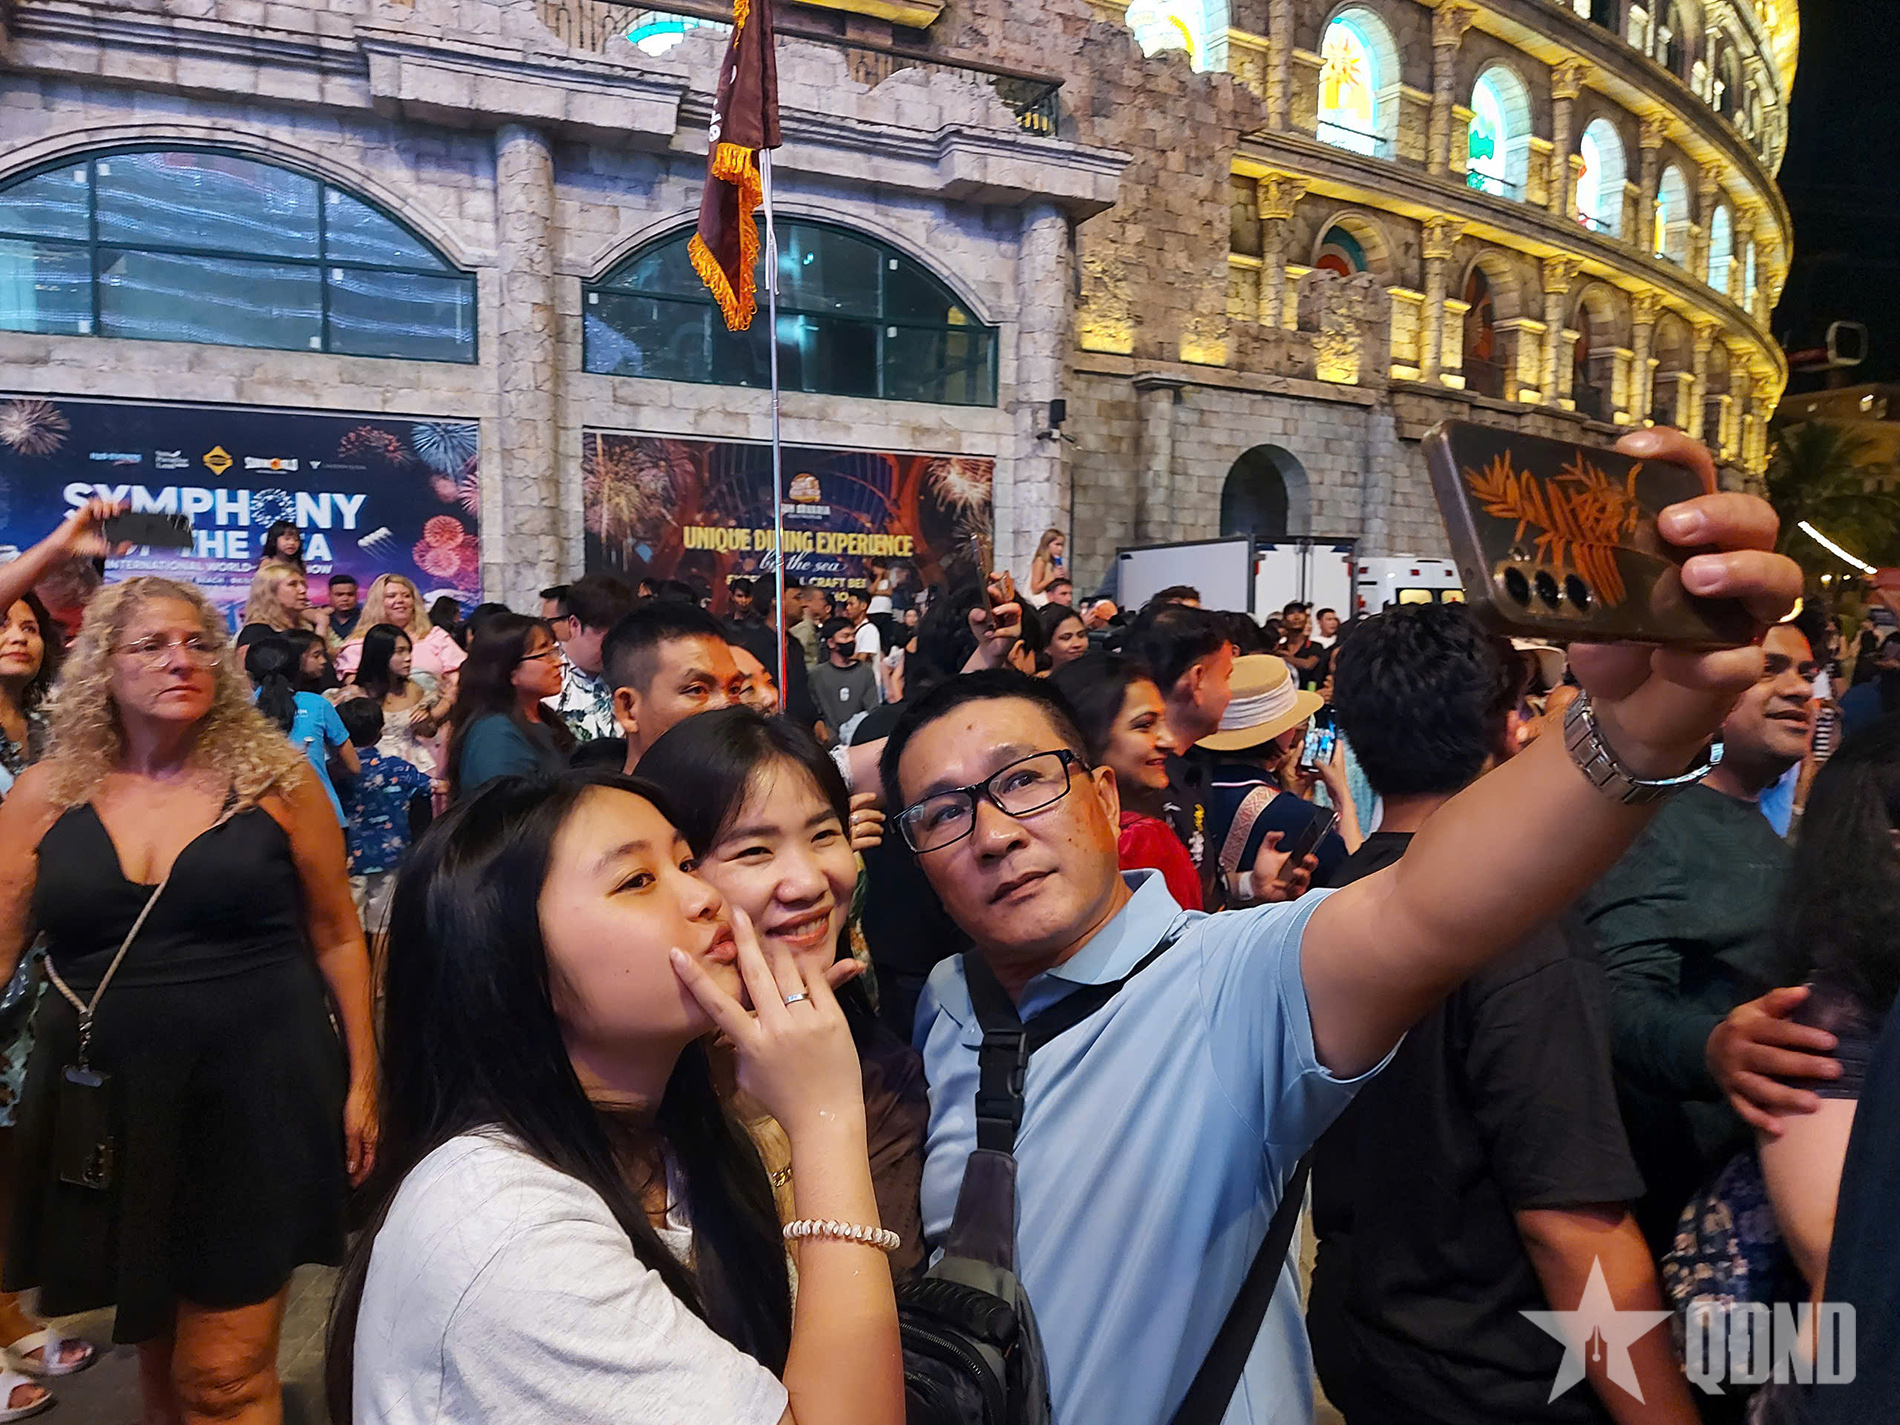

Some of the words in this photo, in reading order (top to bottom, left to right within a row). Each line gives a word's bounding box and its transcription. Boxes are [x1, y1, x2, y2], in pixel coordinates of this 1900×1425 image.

[62, 481, 367, 530] SYMPHONY
[683, 526, 751, 552] UNIQUE
[754, 529, 813, 553] DIING
[815, 532, 914, 557] EXPERIENCE
[785, 550, 813, 571] the
[812, 561, 849, 573] sea
